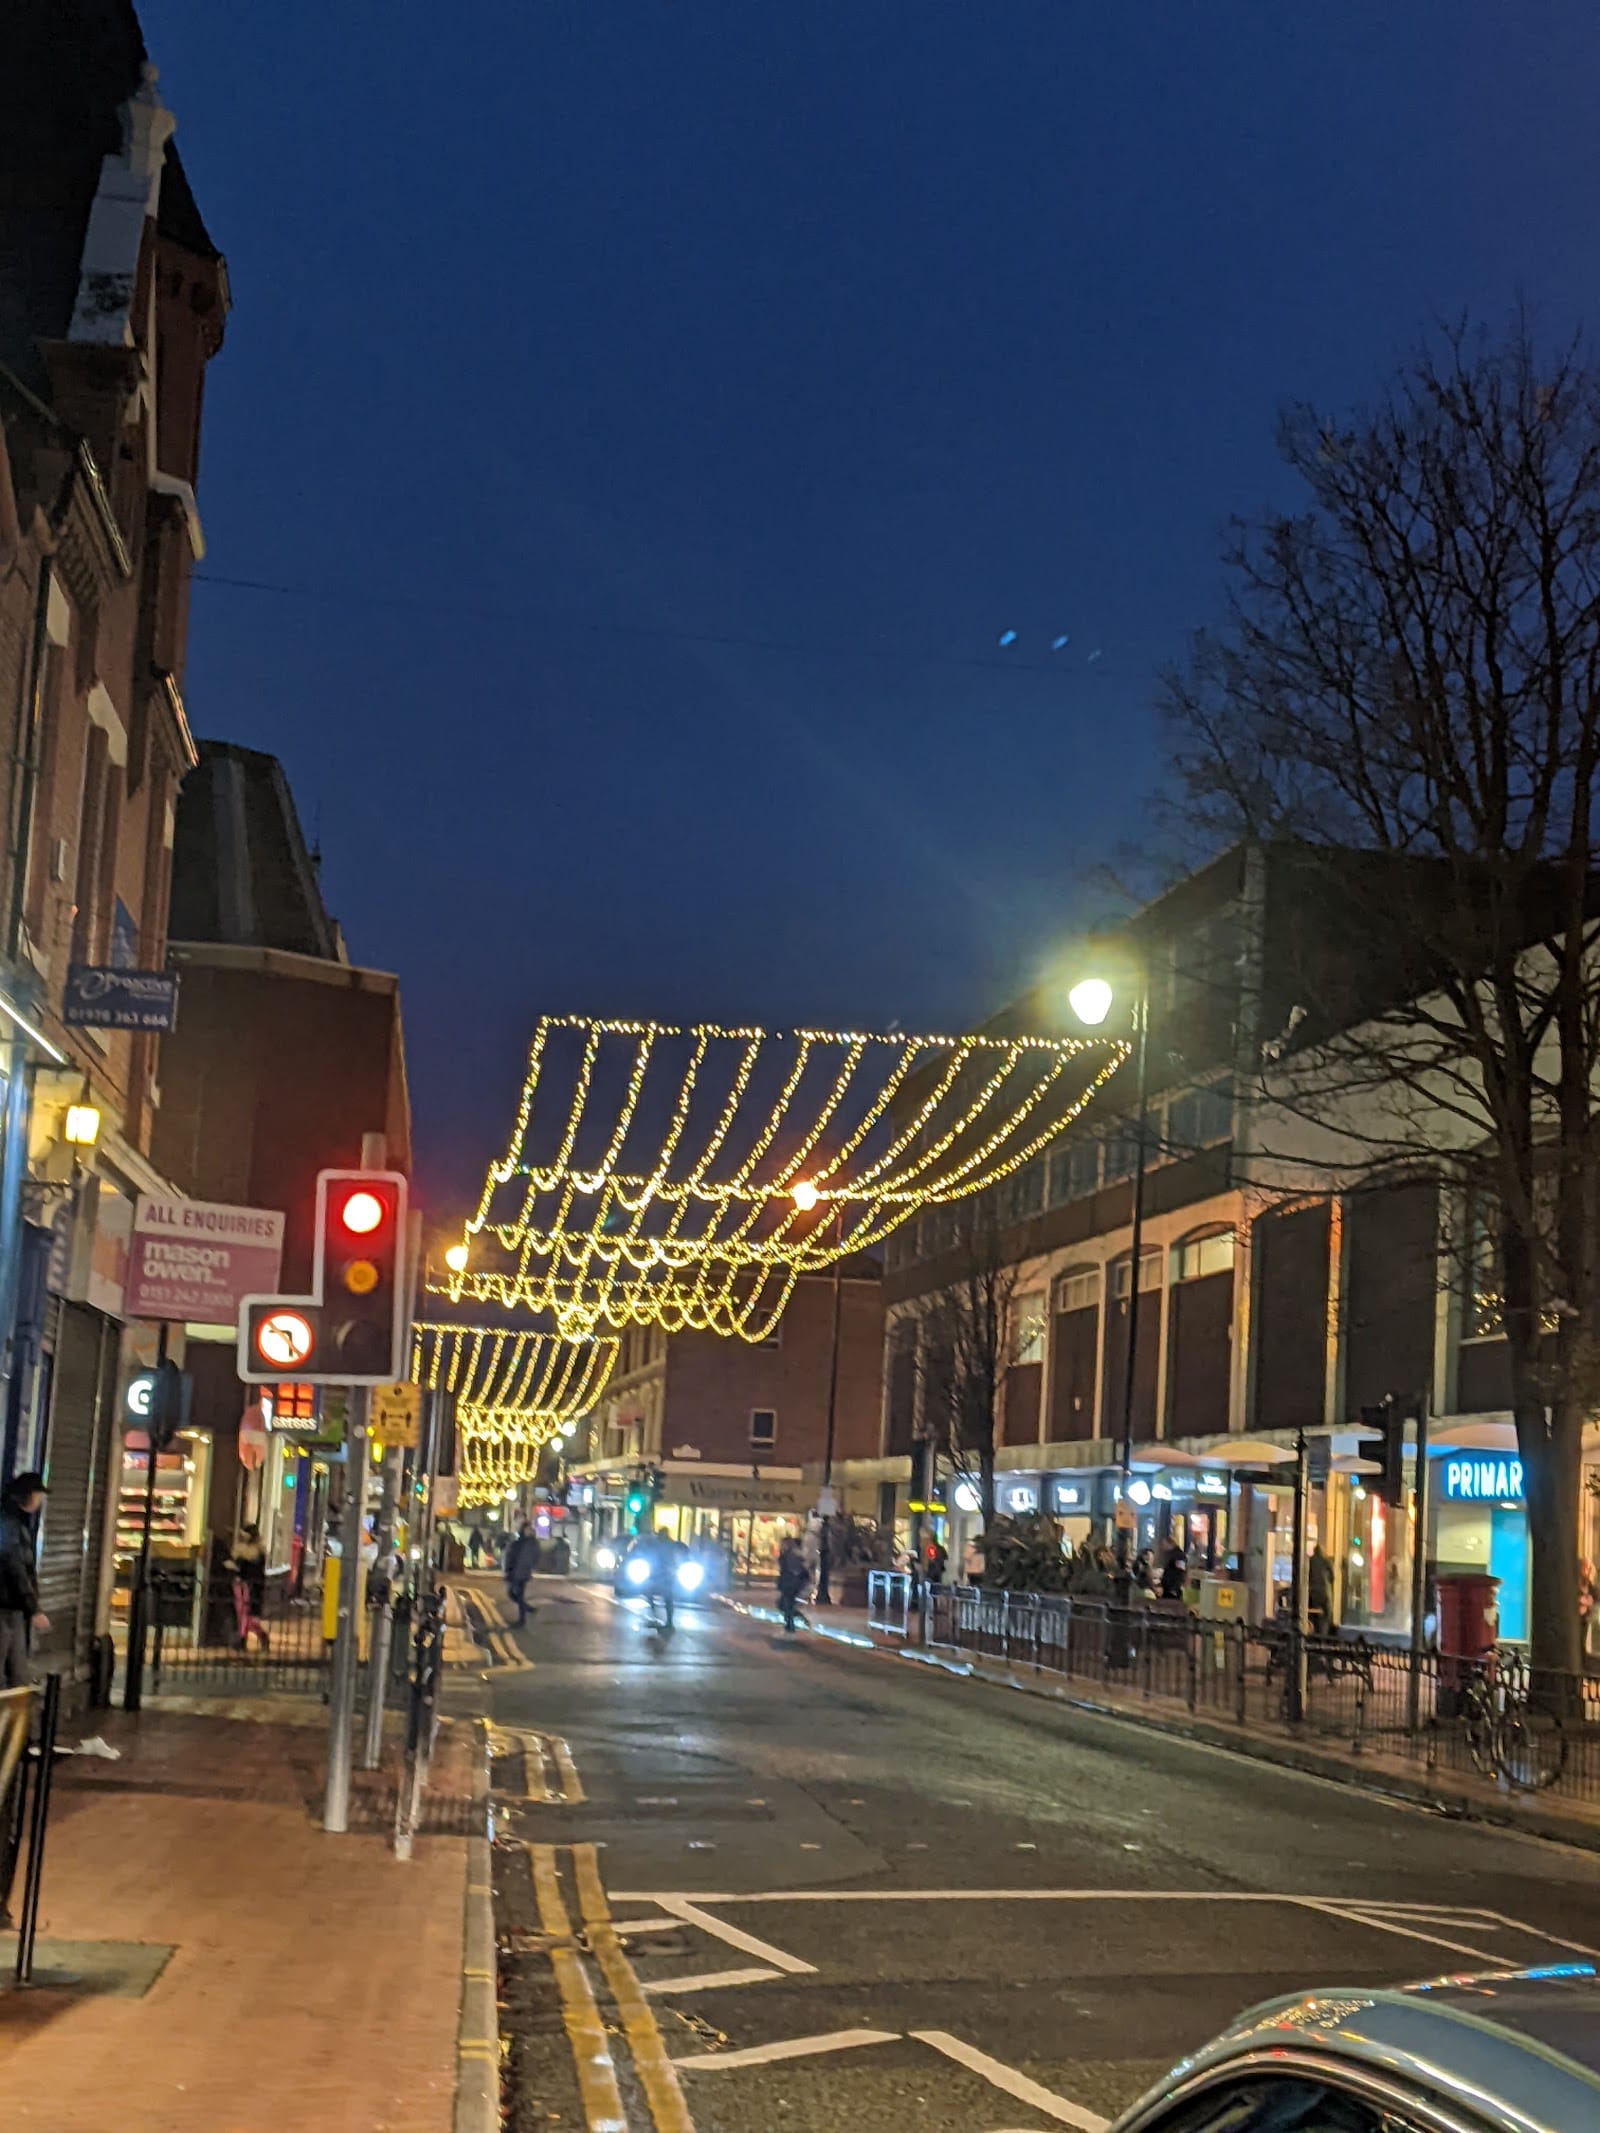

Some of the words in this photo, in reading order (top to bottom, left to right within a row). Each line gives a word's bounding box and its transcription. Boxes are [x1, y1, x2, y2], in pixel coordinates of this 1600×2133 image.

[146, 1203, 177, 1226] ALL
[183, 1209, 276, 1237] ENQUIRIES
[144, 1241, 231, 1269] mason
[143, 1261, 213, 1285] owen
[272, 1416, 318, 1430] GREGGS
[1447, 1461, 1524, 1497] PRIMAR
